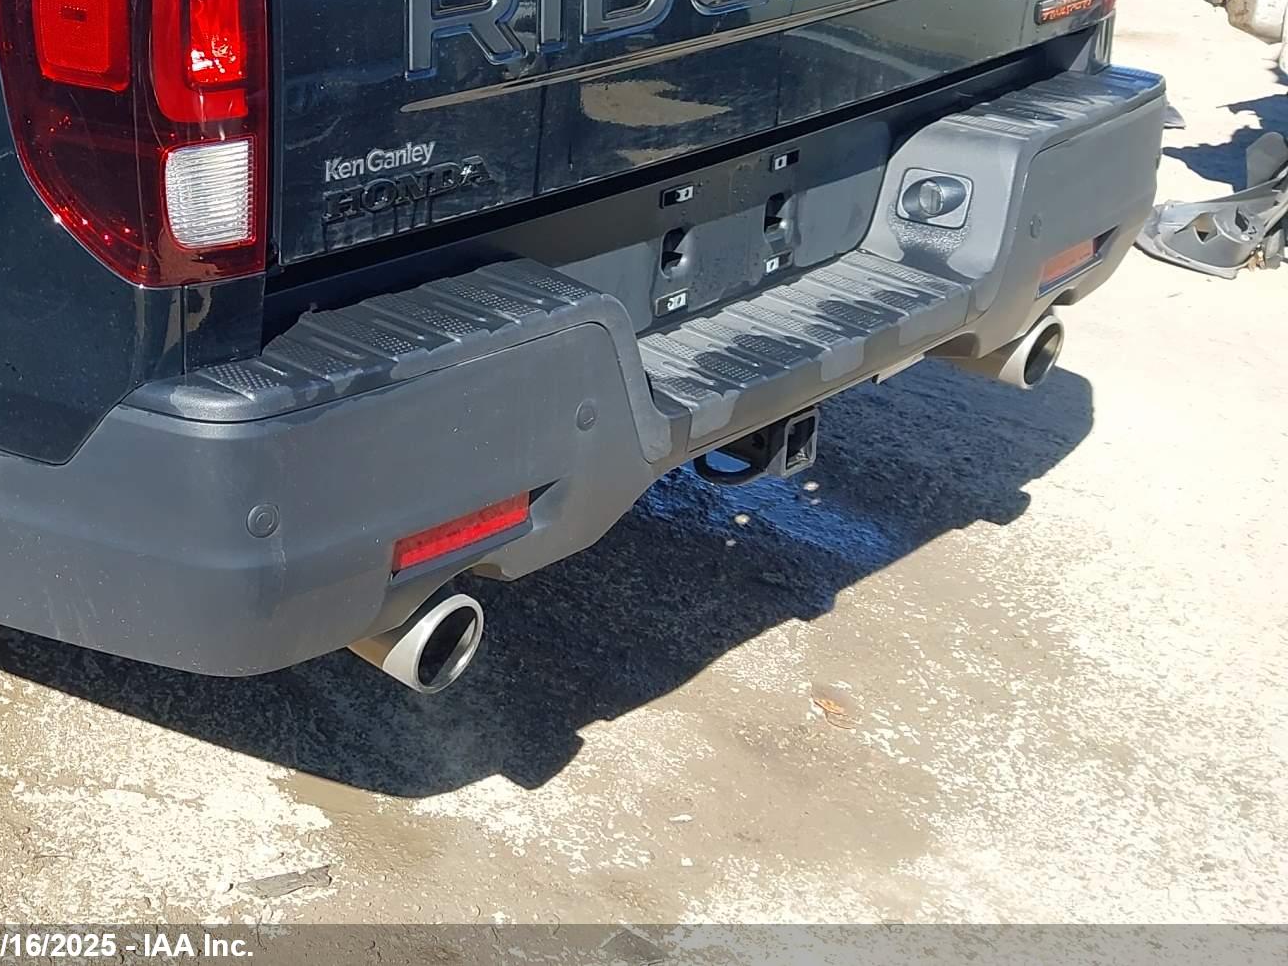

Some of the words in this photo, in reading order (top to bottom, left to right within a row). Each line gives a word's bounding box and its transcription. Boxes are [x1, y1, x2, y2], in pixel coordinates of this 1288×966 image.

[321, 154, 496, 226] HONDA
[324, 157, 365, 183] Ken
[367, 140, 436, 173] Ganley
